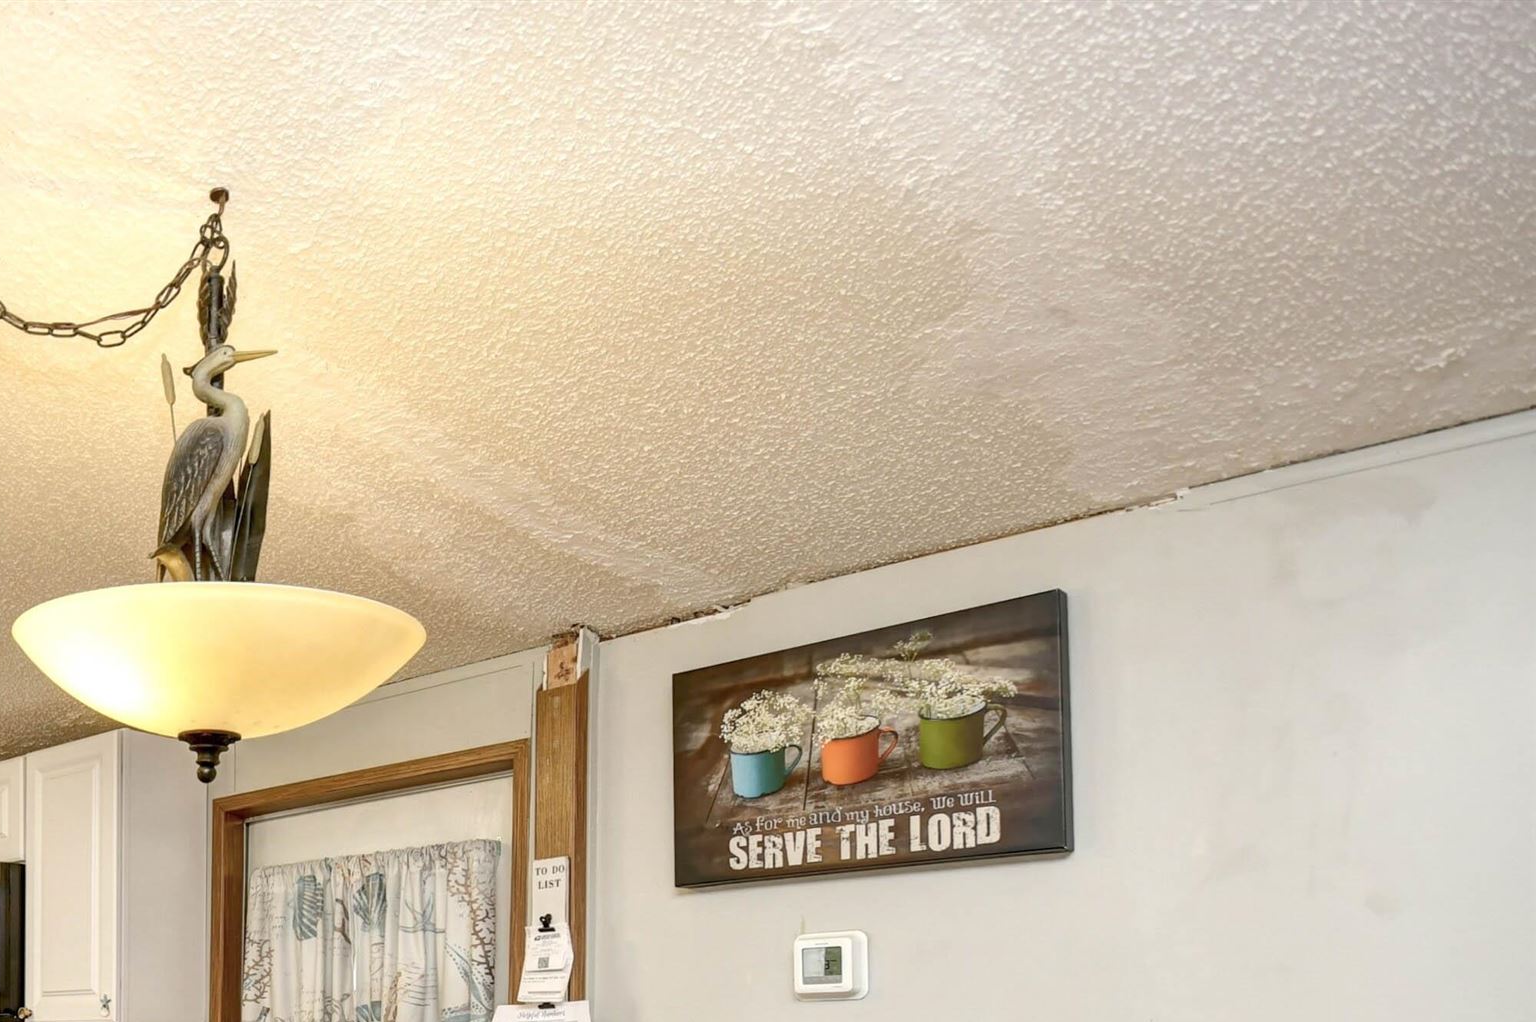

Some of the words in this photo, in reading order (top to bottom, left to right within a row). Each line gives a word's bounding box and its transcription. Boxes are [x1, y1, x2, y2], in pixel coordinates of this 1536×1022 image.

[732, 821, 753, 836] As
[755, 815, 784, 832] for
[785, 815, 807, 830] me
[808, 806, 843, 826] and
[844, 809, 870, 825] my
[728, 827, 823, 871] SERVE
[835, 817, 897, 861] THE
[909, 805, 1002, 853] LORD
[535, 866, 548, 876] TO
[552, 865, 565, 874] DO
[538, 878, 562, 890] LIST
